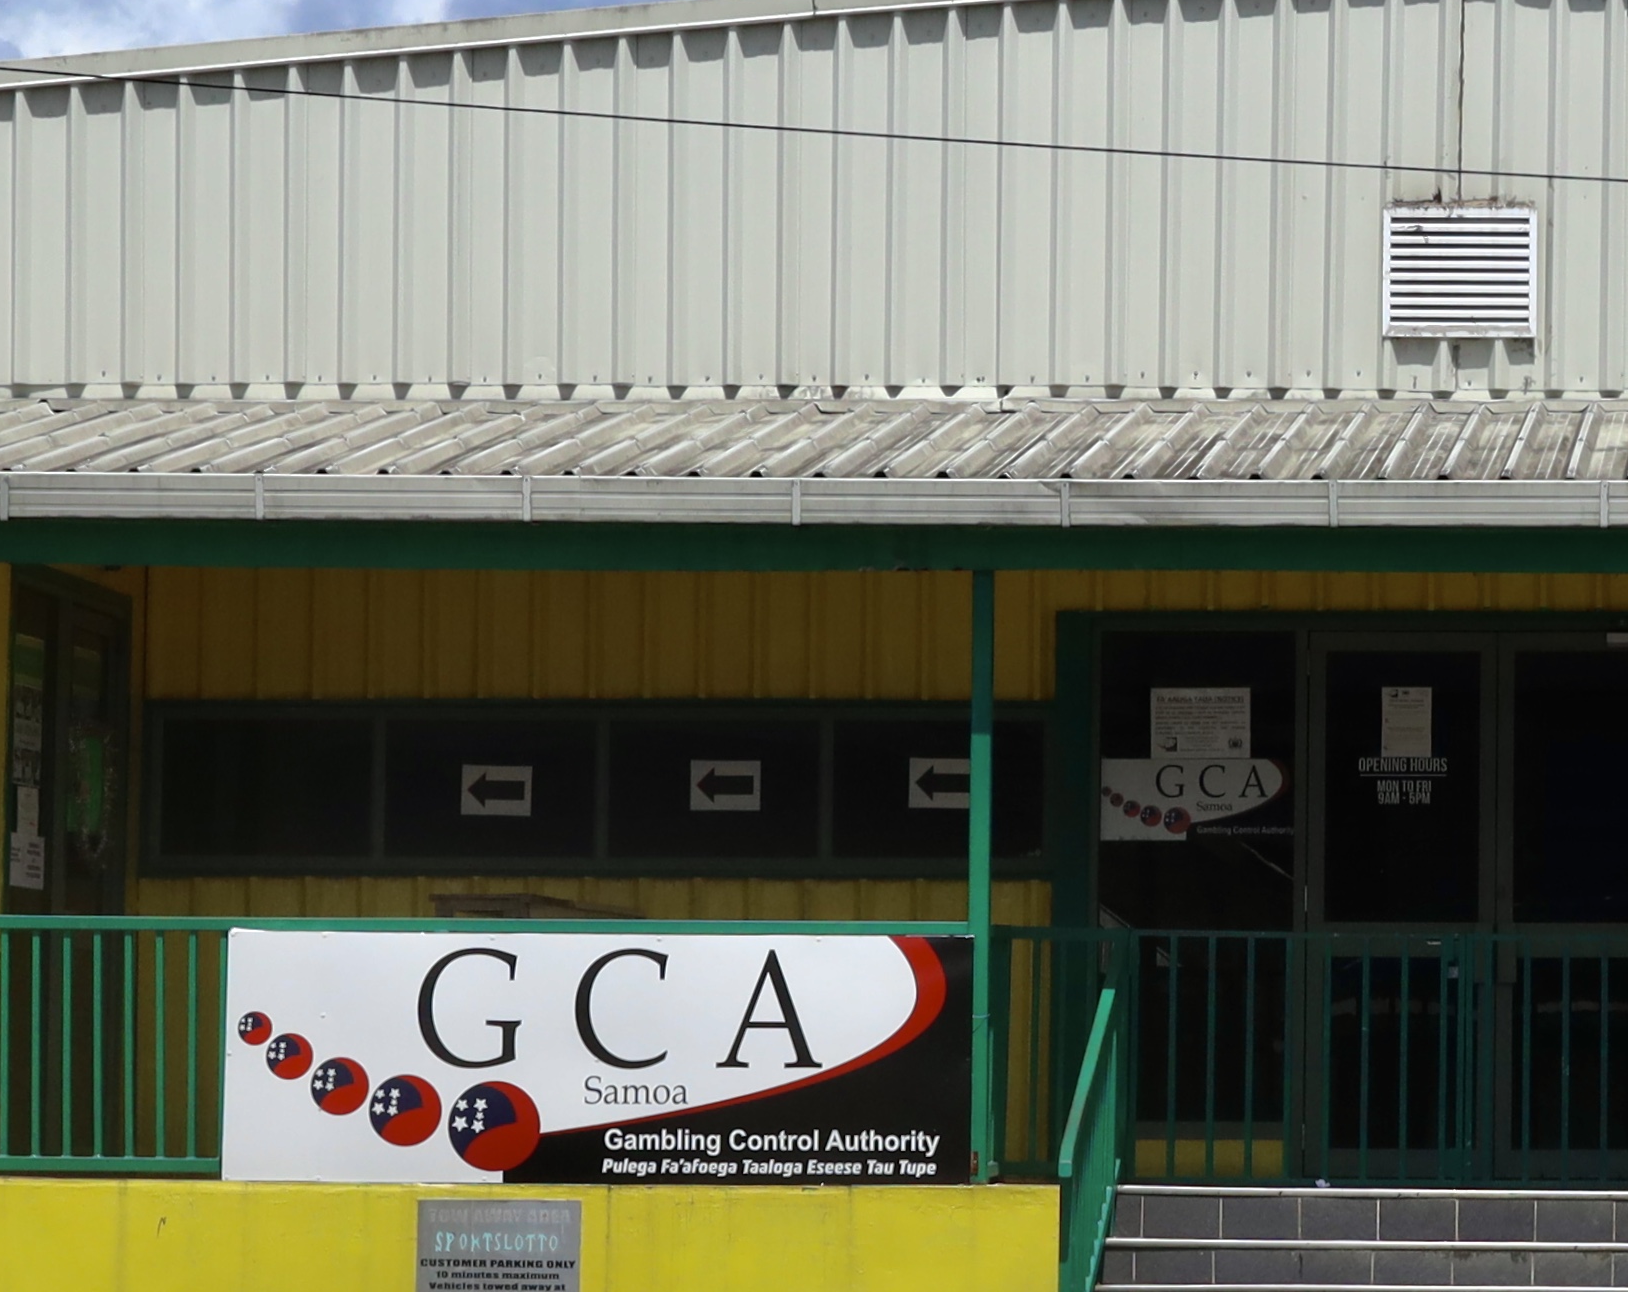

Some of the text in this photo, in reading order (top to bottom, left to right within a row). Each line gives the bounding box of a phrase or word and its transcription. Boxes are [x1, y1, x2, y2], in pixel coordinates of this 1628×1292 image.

[1358, 757, 1448, 772] OPENING HOURS
[1376, 779, 1432, 793] MON TO FRI
[1377, 792, 1400, 805] 9AM
[1408, 792, 1431, 805] 5PM
[1196, 801, 1233, 812] Samoa
[1196, 825, 1232, 836] Gambling
[1232, 825, 1260, 835] Control
[583, 1076, 689, 1106] Samoa
[603, 1127, 940, 1157] Gambling Control Authority
[601, 1158, 938, 1178] Pulega Fa'afoega Taaloga Eseese Tau Tupe
[420, 1258, 576, 1270] CUSTOMER PARKING ONLY
[436, 1270, 559, 1280] 10 minutes maximum
[429, 1281, 566, 1292] Vehicles towed away at
